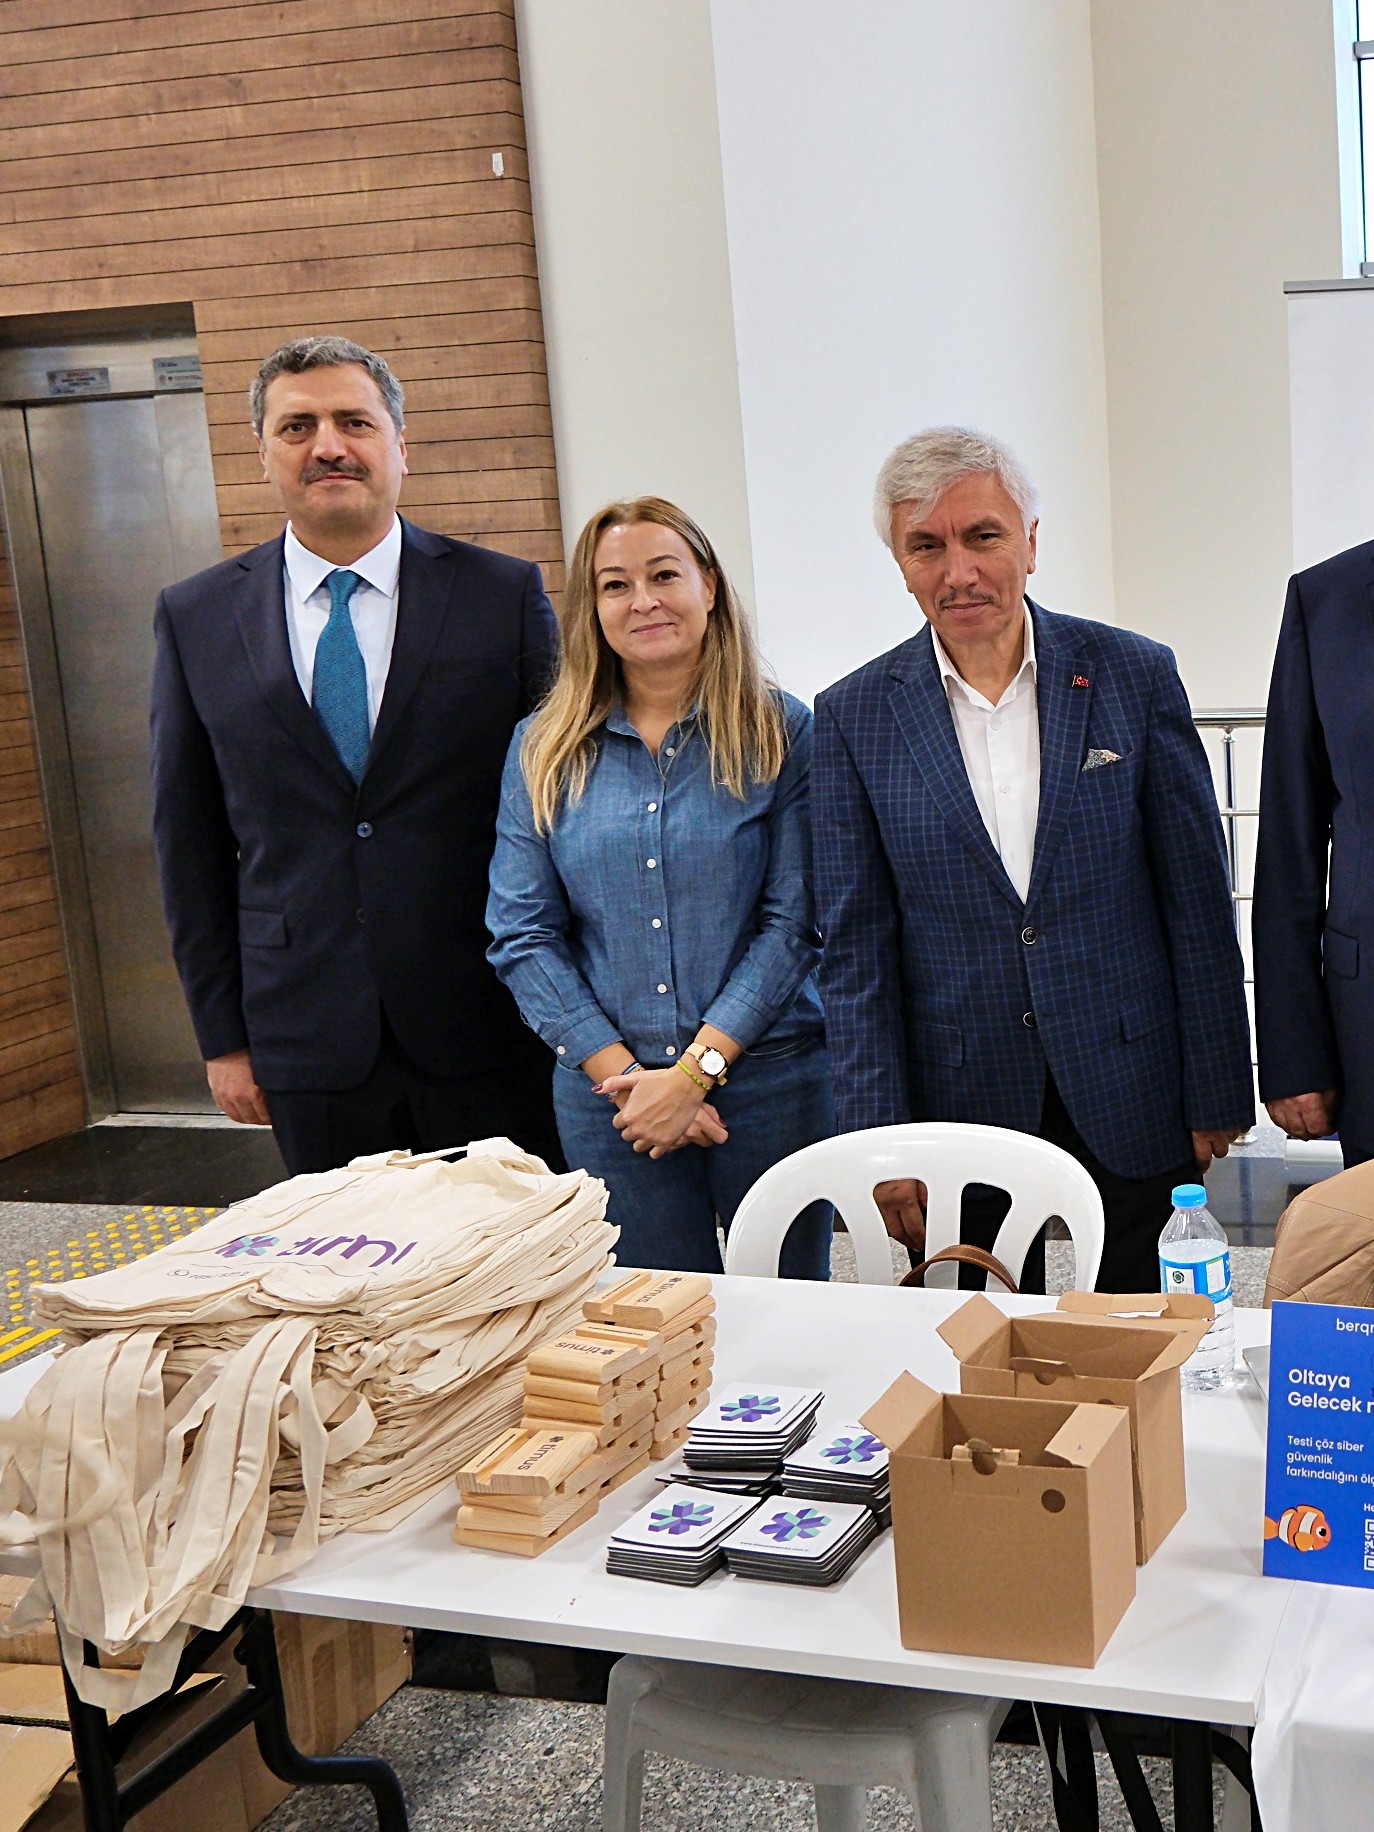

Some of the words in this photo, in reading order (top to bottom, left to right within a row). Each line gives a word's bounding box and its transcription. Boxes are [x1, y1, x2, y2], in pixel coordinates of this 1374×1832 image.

[637, 1281, 675, 1304] timus
[555, 1341, 603, 1355] timus
[1288, 1368, 1351, 1392] Oltaya
[1287, 1391, 1362, 1413] Gelecek
[1287, 1435, 1313, 1447] Testi
[1315, 1438, 1335, 1450] çöz
[1336, 1440, 1365, 1452] siber
[517, 1444, 557, 1470] timus
[1286, 1451, 1333, 1464] güvenlik
[1286, 1465, 1358, 1484] farkındalığını
